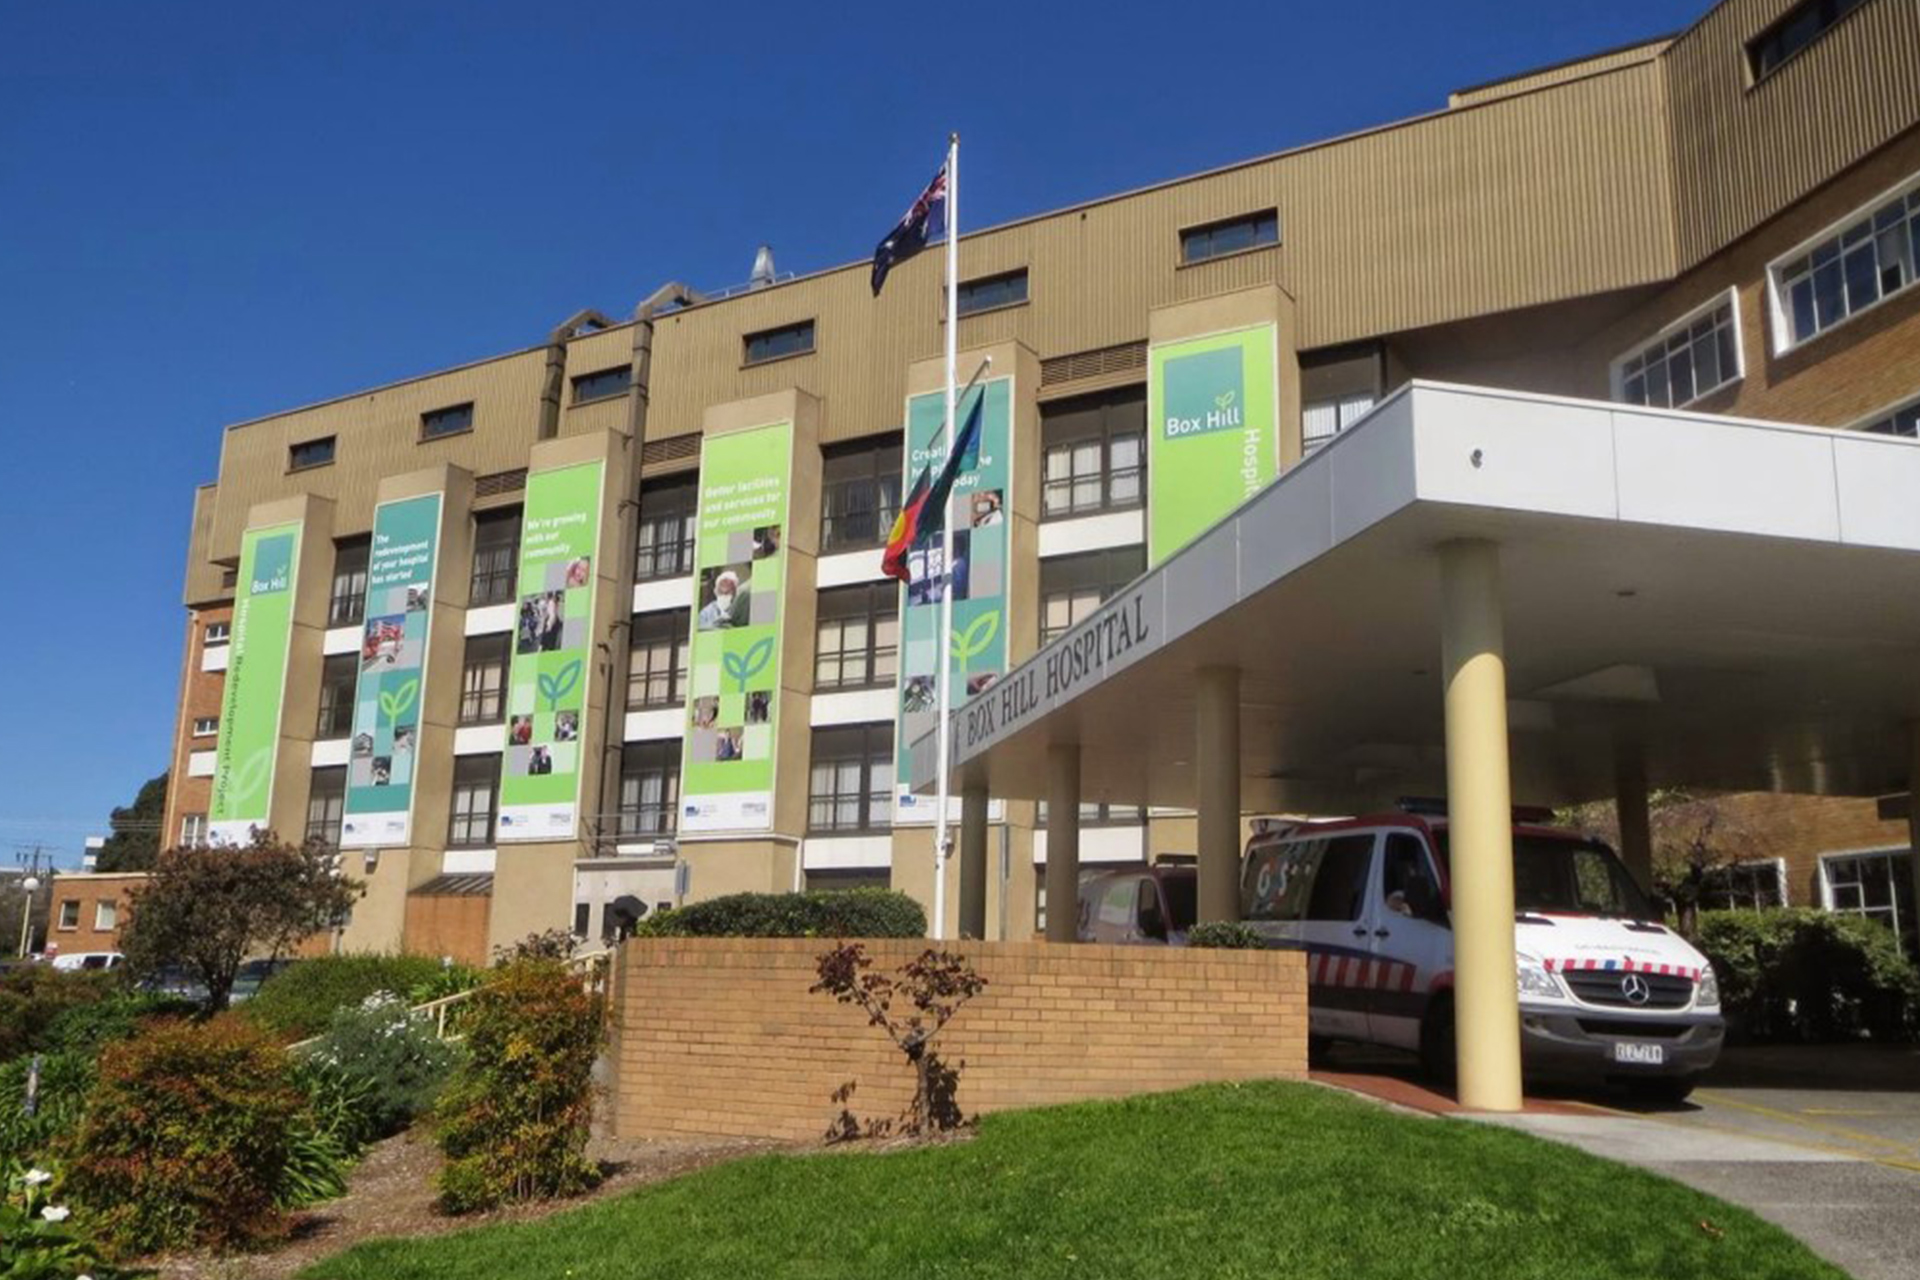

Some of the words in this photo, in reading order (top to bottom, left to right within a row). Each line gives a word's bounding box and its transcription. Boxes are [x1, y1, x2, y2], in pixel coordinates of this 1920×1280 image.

[1167, 417, 1201, 436] Box
[1207, 407, 1241, 429] Hill
[705, 485, 735, 498] Better
[737, 477, 780, 492] facilities
[953, 474, 981, 488] oday
[705, 501, 722, 513] and
[725, 496, 764, 510] services
[766, 492, 781, 503] for
[527, 517, 550, 530] We're
[553, 512, 587, 529] growing
[704, 519, 719, 529] our
[722, 509, 776, 527] community
[376, 534, 389, 545] The
[525, 533, 543, 546] with
[545, 531, 559, 541] our
[374, 541, 429, 557] redevelopment
[525, 543, 571, 560] community
[381, 560, 398, 572] your
[399, 552, 429, 567] hospital
[251, 580, 269, 594] Box
[270, 576, 288, 590] Hill
[371, 576, 384, 584] has
[385, 569, 413, 582] started
[236, 599, 250, 653] Hospital
[966, 697, 996, 747] BOX
[1001, 669, 1039, 727] HILL
[1046, 594, 1149, 699] HOSPITAL
[225, 655, 243, 761] Redevelopment
[217, 765, 231, 815] Project
